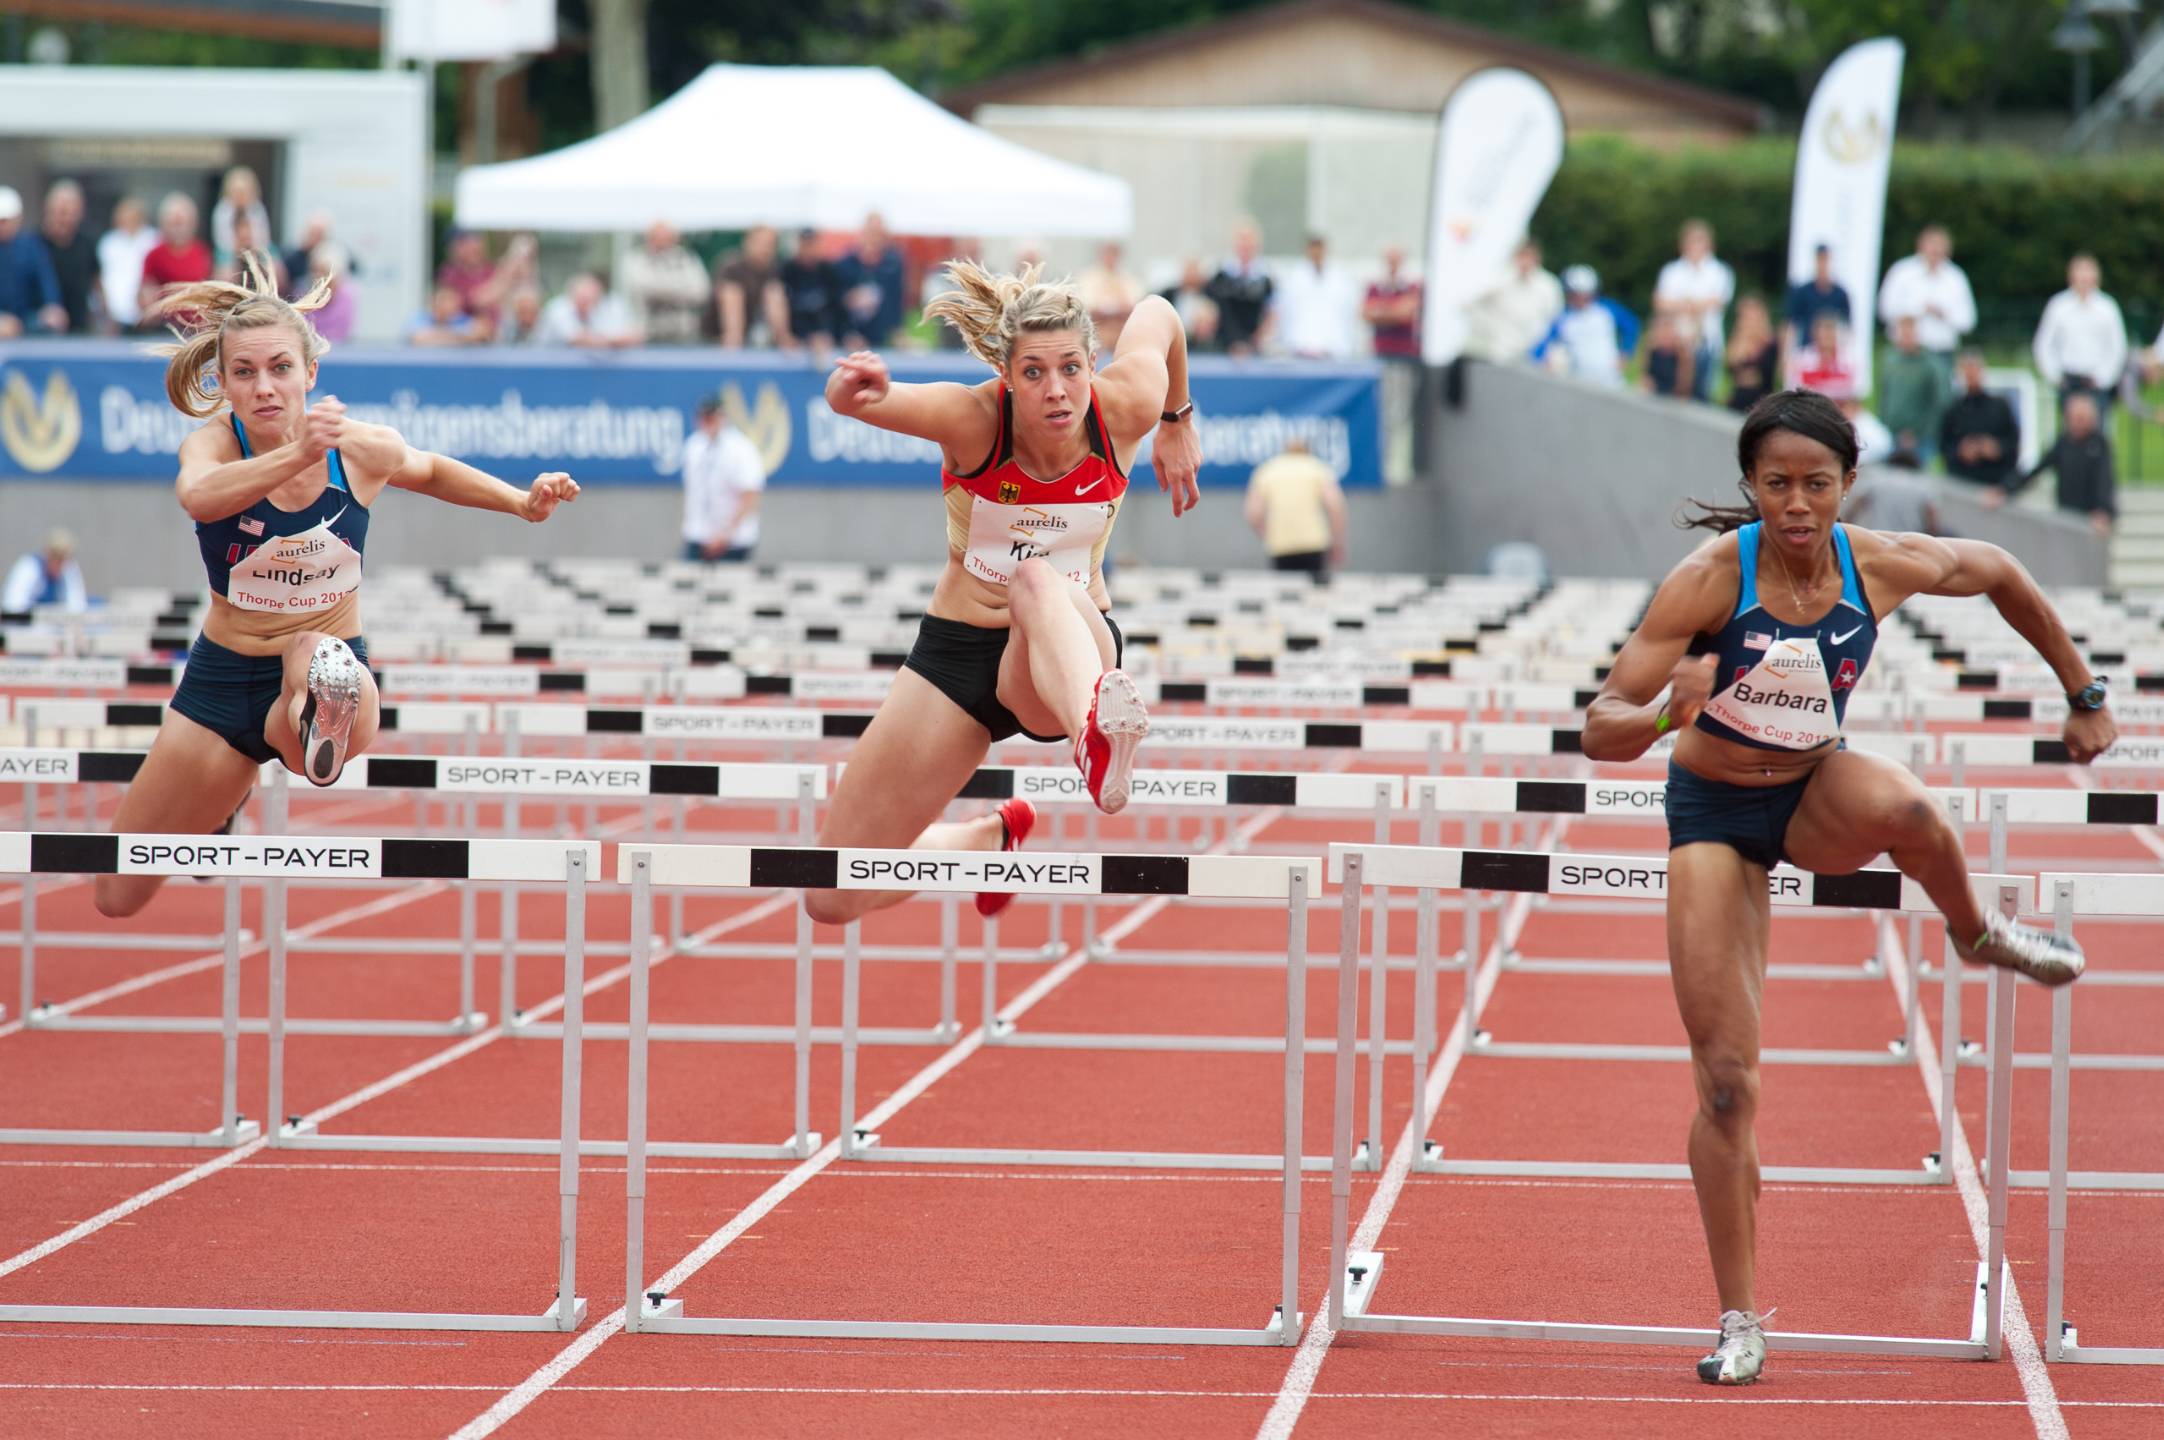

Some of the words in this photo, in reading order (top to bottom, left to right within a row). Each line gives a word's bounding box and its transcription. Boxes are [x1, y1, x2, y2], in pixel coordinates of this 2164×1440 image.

[1016, 516, 1068, 529] aurelis
[276, 538, 326, 558] aurelis
[973, 556, 1008, 584] Thorp
[237, 591, 285, 608] Thorpe
[289, 594, 317, 608] Cup
[1771, 653, 1822, 669] aurelis
[1733, 682, 1828, 714] Barbara
[1715, 703, 1760, 734] Thorpe
[1764, 724, 1794, 741] Cup
[1148, 725, 1297, 741] PORT-PAYER
[447, 766, 641, 787] SPORT-PAYER
[130, 845, 370, 868] SPORT-PAYER
[850, 860, 1090, 883] SPORT-PAYER
